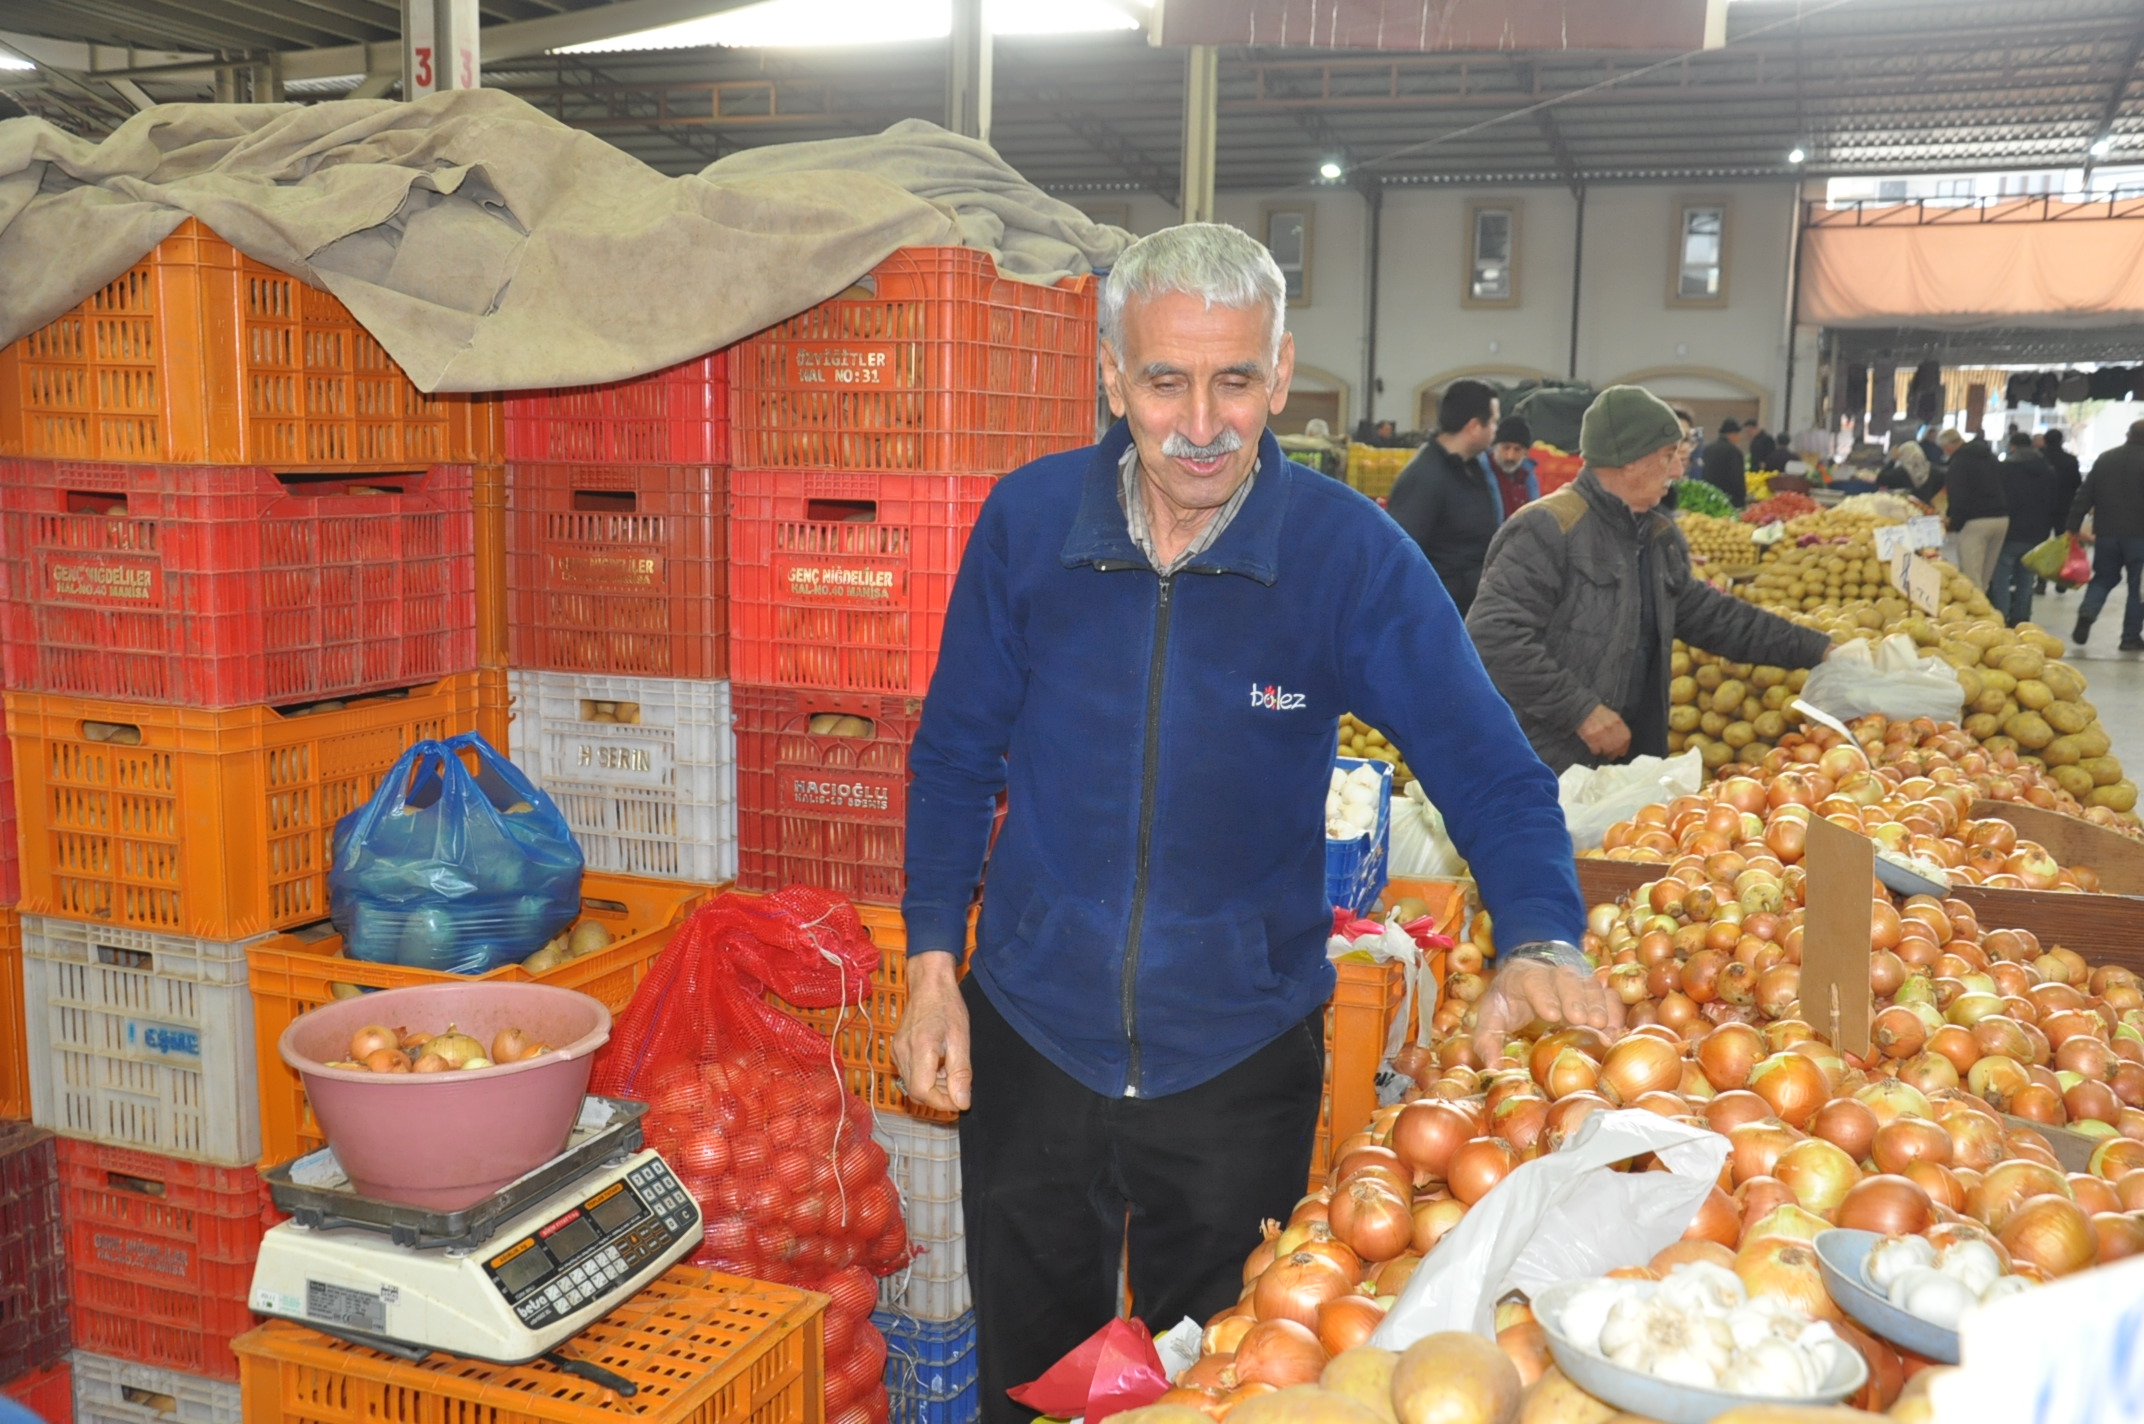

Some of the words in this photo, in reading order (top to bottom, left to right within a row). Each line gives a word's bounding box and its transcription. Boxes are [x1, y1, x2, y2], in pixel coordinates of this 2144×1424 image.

[415, 47, 432, 88] 3
[460, 48, 473, 89] 3
[834, 369, 880, 383] NO:31
[577, 745, 592, 767] H
[681, 1210, 689, 1219] C
